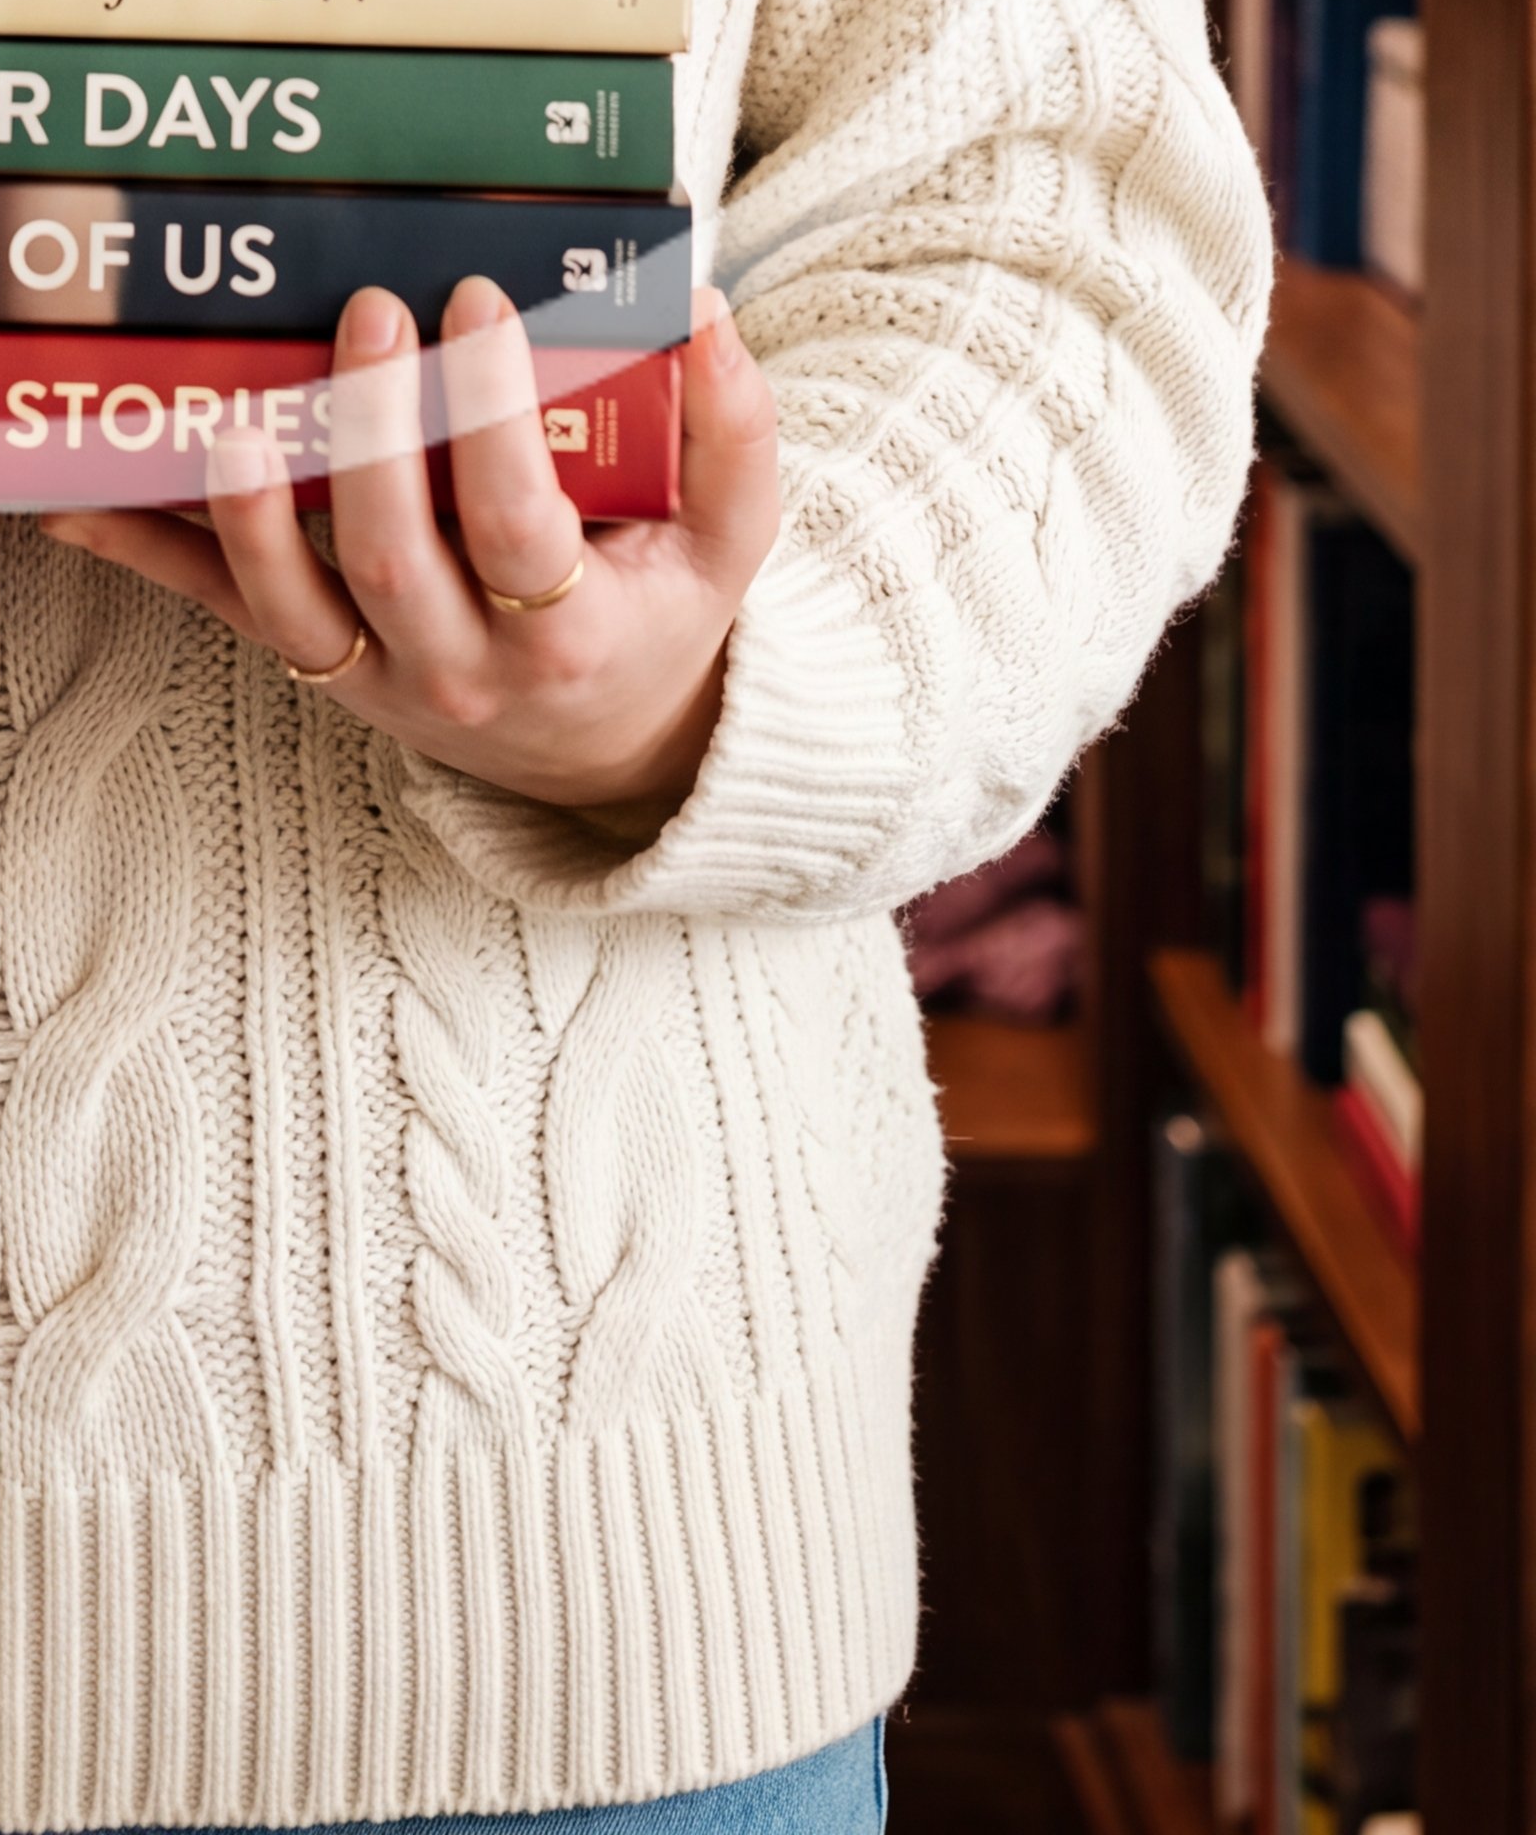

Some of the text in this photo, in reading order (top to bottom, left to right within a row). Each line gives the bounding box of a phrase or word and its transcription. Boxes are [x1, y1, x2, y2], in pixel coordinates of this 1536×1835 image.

[85, 73, 321, 152] DAYS
[9, 219, 134, 291] OF
[166, 224, 275, 295] US
